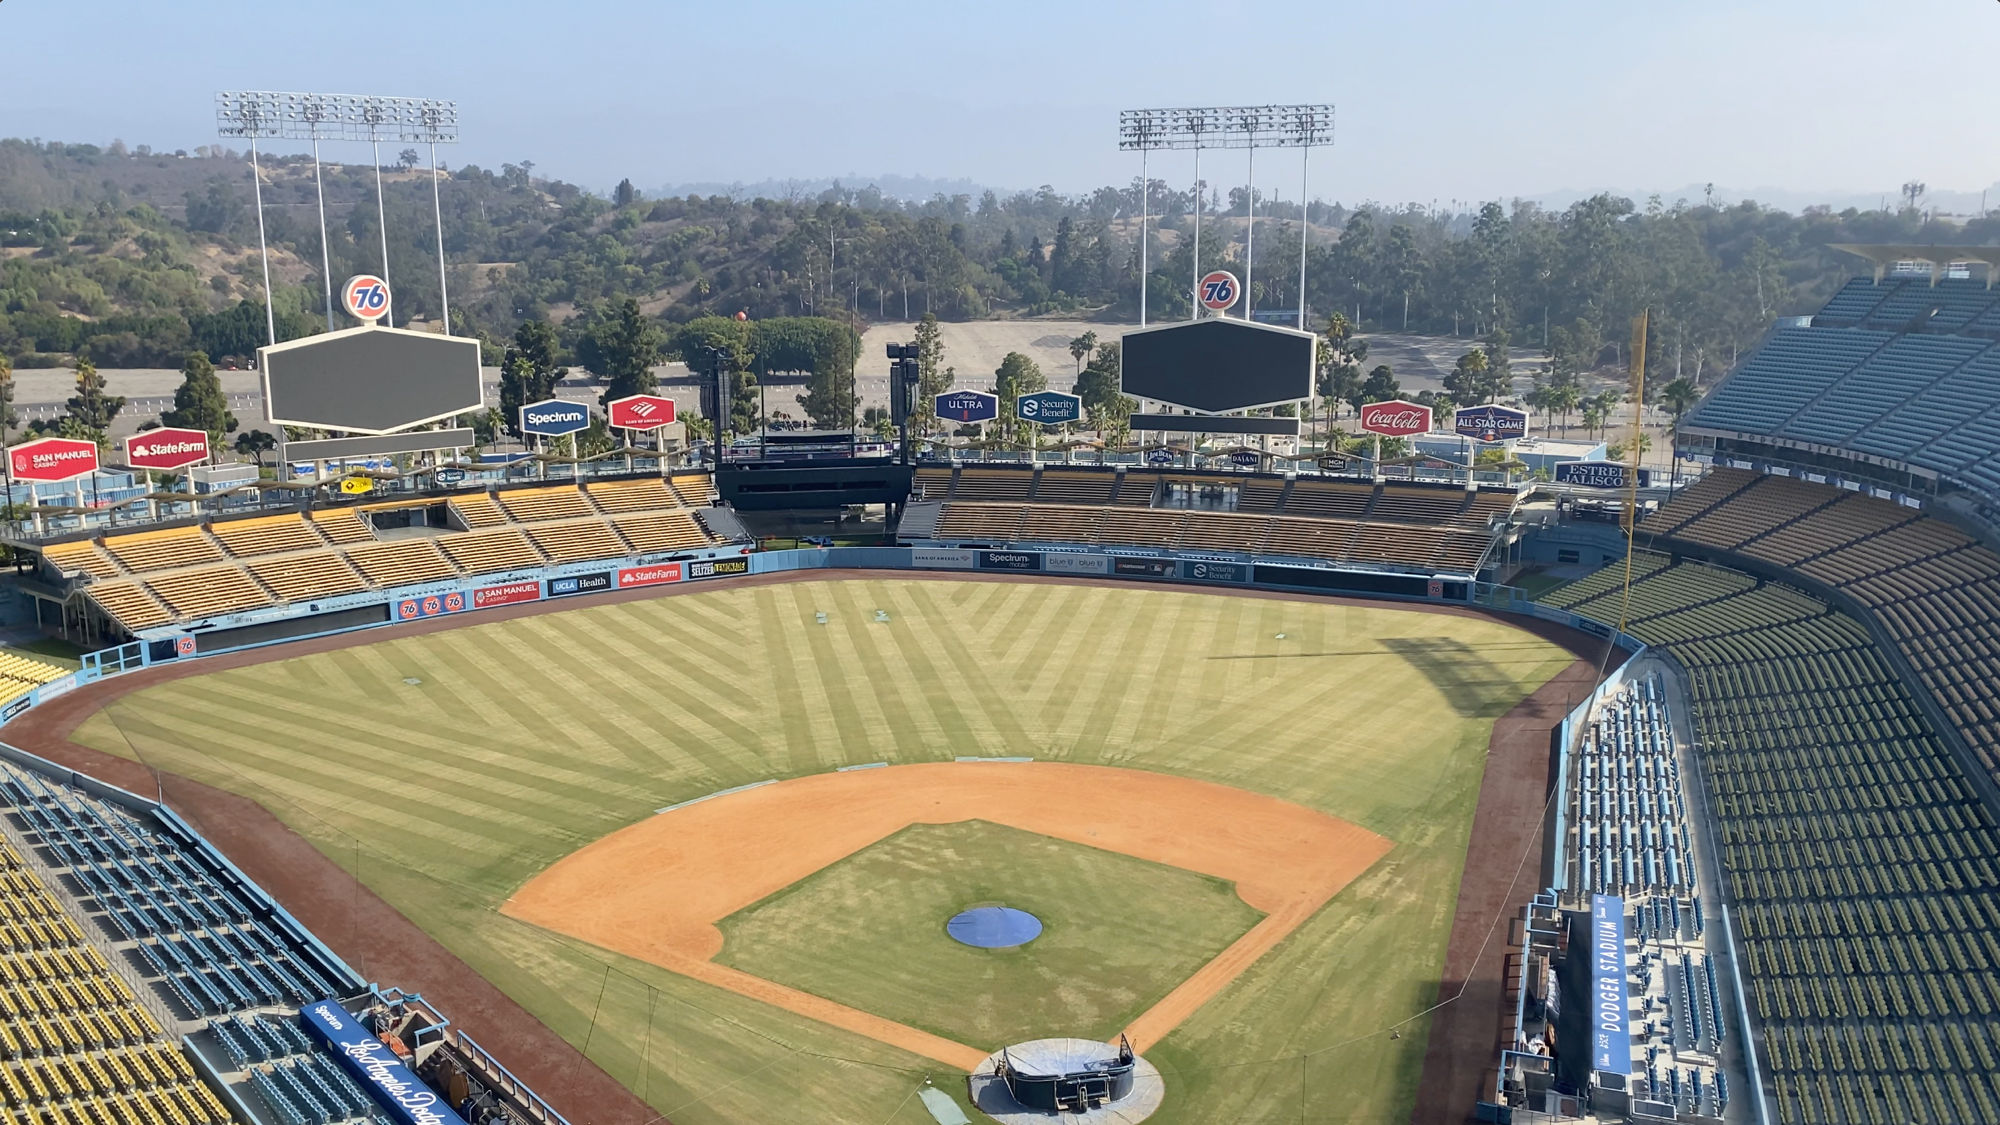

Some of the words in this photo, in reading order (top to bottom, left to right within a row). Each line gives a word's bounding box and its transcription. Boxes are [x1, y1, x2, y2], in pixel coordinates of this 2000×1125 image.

[354, 283, 385, 309] 76
[1204, 279, 1233, 302] 76
[948, 400, 984, 409] ULTRA
[1041, 399, 1075, 410] Security
[1041, 408, 1071, 417] Benefit
[527, 411, 581, 426] Spectrum
[1366, 409, 1424, 429] Coca-Cola
[1457, 418, 1473, 428] ALL
[1474, 418, 1496, 429] STAR
[1497, 419, 1524, 430] GAME
[32, 453, 54, 464] SAN
[54, 450, 94, 462] MANUEL
[1232, 455, 1257, 463] DASANI
[33, 460, 57, 469] CASINO
[1562, 474, 1624, 487] JALISCO
[989, 553, 1028, 563] Spectrum
[1208, 565, 1236, 574] Security
[1208, 571, 1232, 580] Benefit
[555, 581, 575, 591] UCLA
[579, 576, 607, 588] Health
[485, 588, 503, 598] SAN
[503, 584, 538, 596] MANUEL
[1430, 585, 1440, 594] 76
[426, 601, 438, 610] 76
[448, 597, 460, 606] 76
[404, 604, 415, 614] 76
[181, 641, 193, 651] 76
[1599, 921, 1617, 972] STADIUM
[1600, 978, 1621, 1032] DODGER
[314, 1004, 344, 1031] Spectrum
[340, 1038, 383, 1063] Los
[358, 1057, 413, 1098] Angeles
